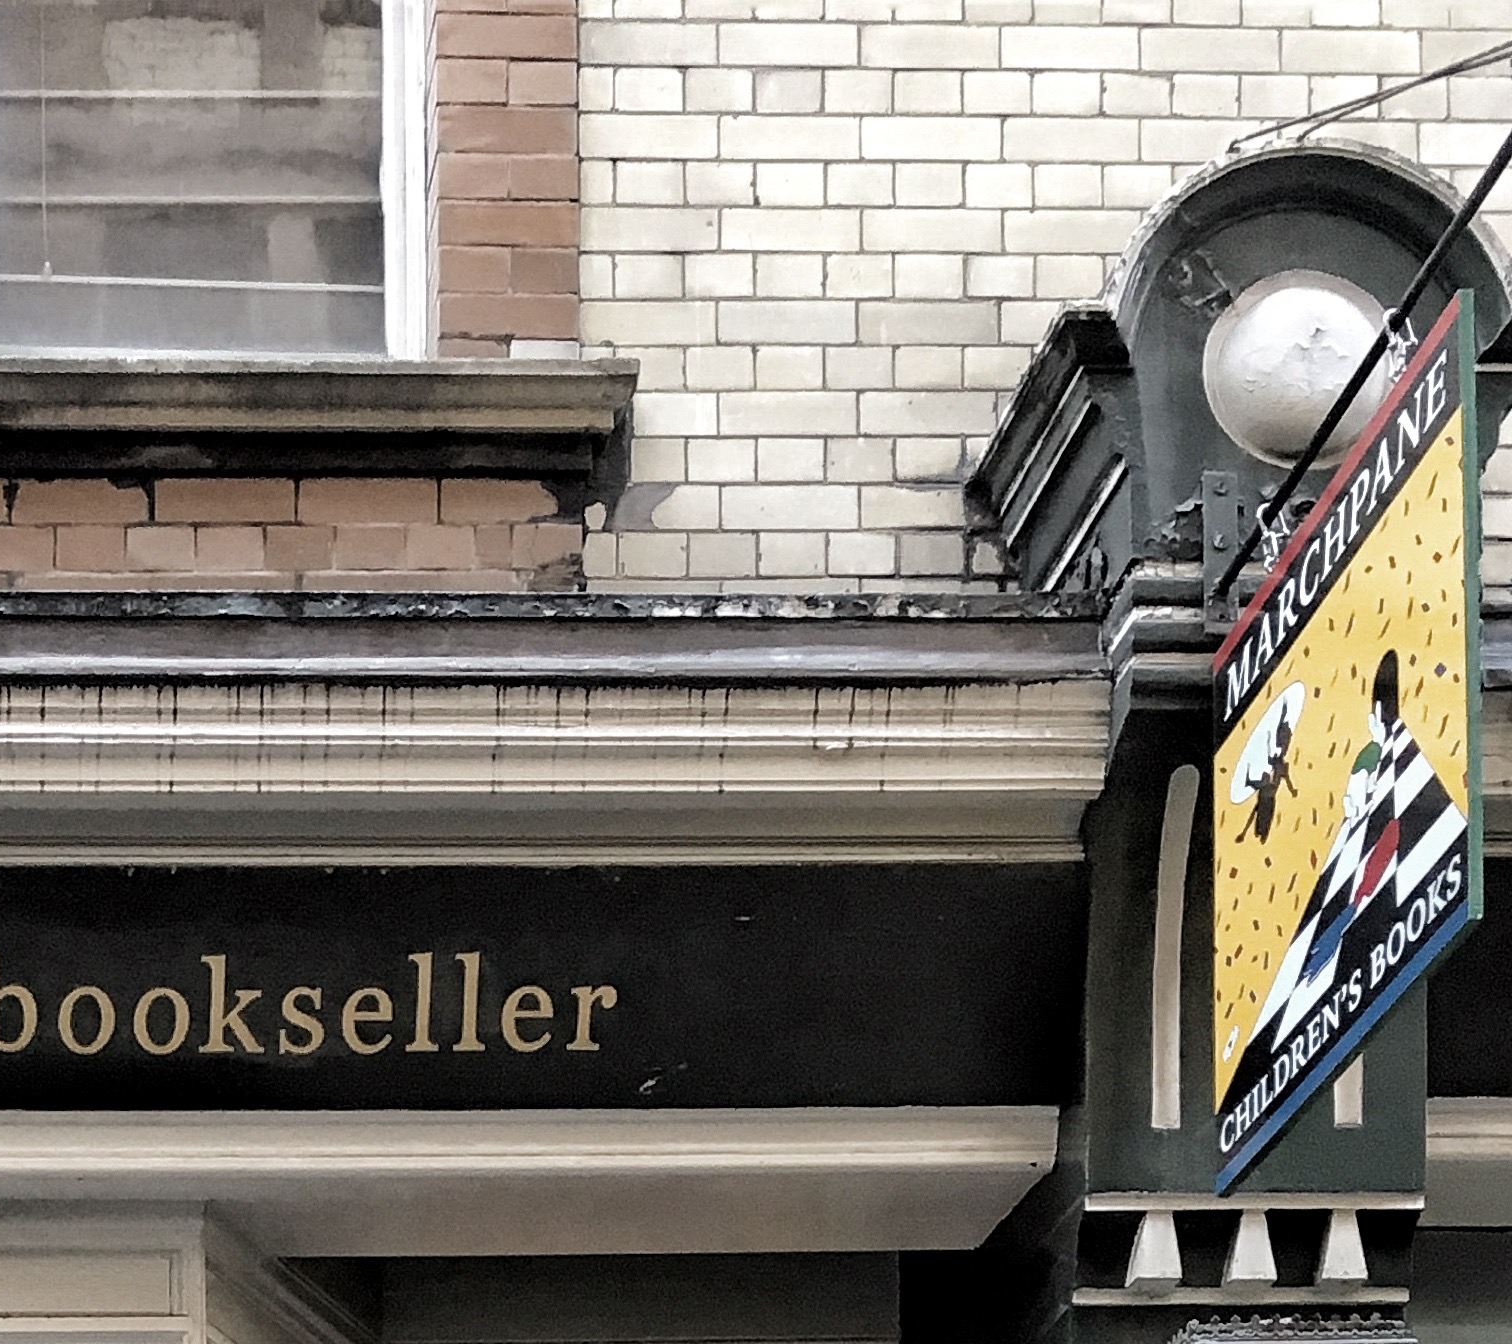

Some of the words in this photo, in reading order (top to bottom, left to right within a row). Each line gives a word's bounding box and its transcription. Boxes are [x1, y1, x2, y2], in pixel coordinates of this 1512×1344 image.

[1222, 348, 1450, 722] MARCHPANE
[1218, 970, 1364, 1156] CHILDREN'S
[1368, 861, 1465, 988] BOOKS
